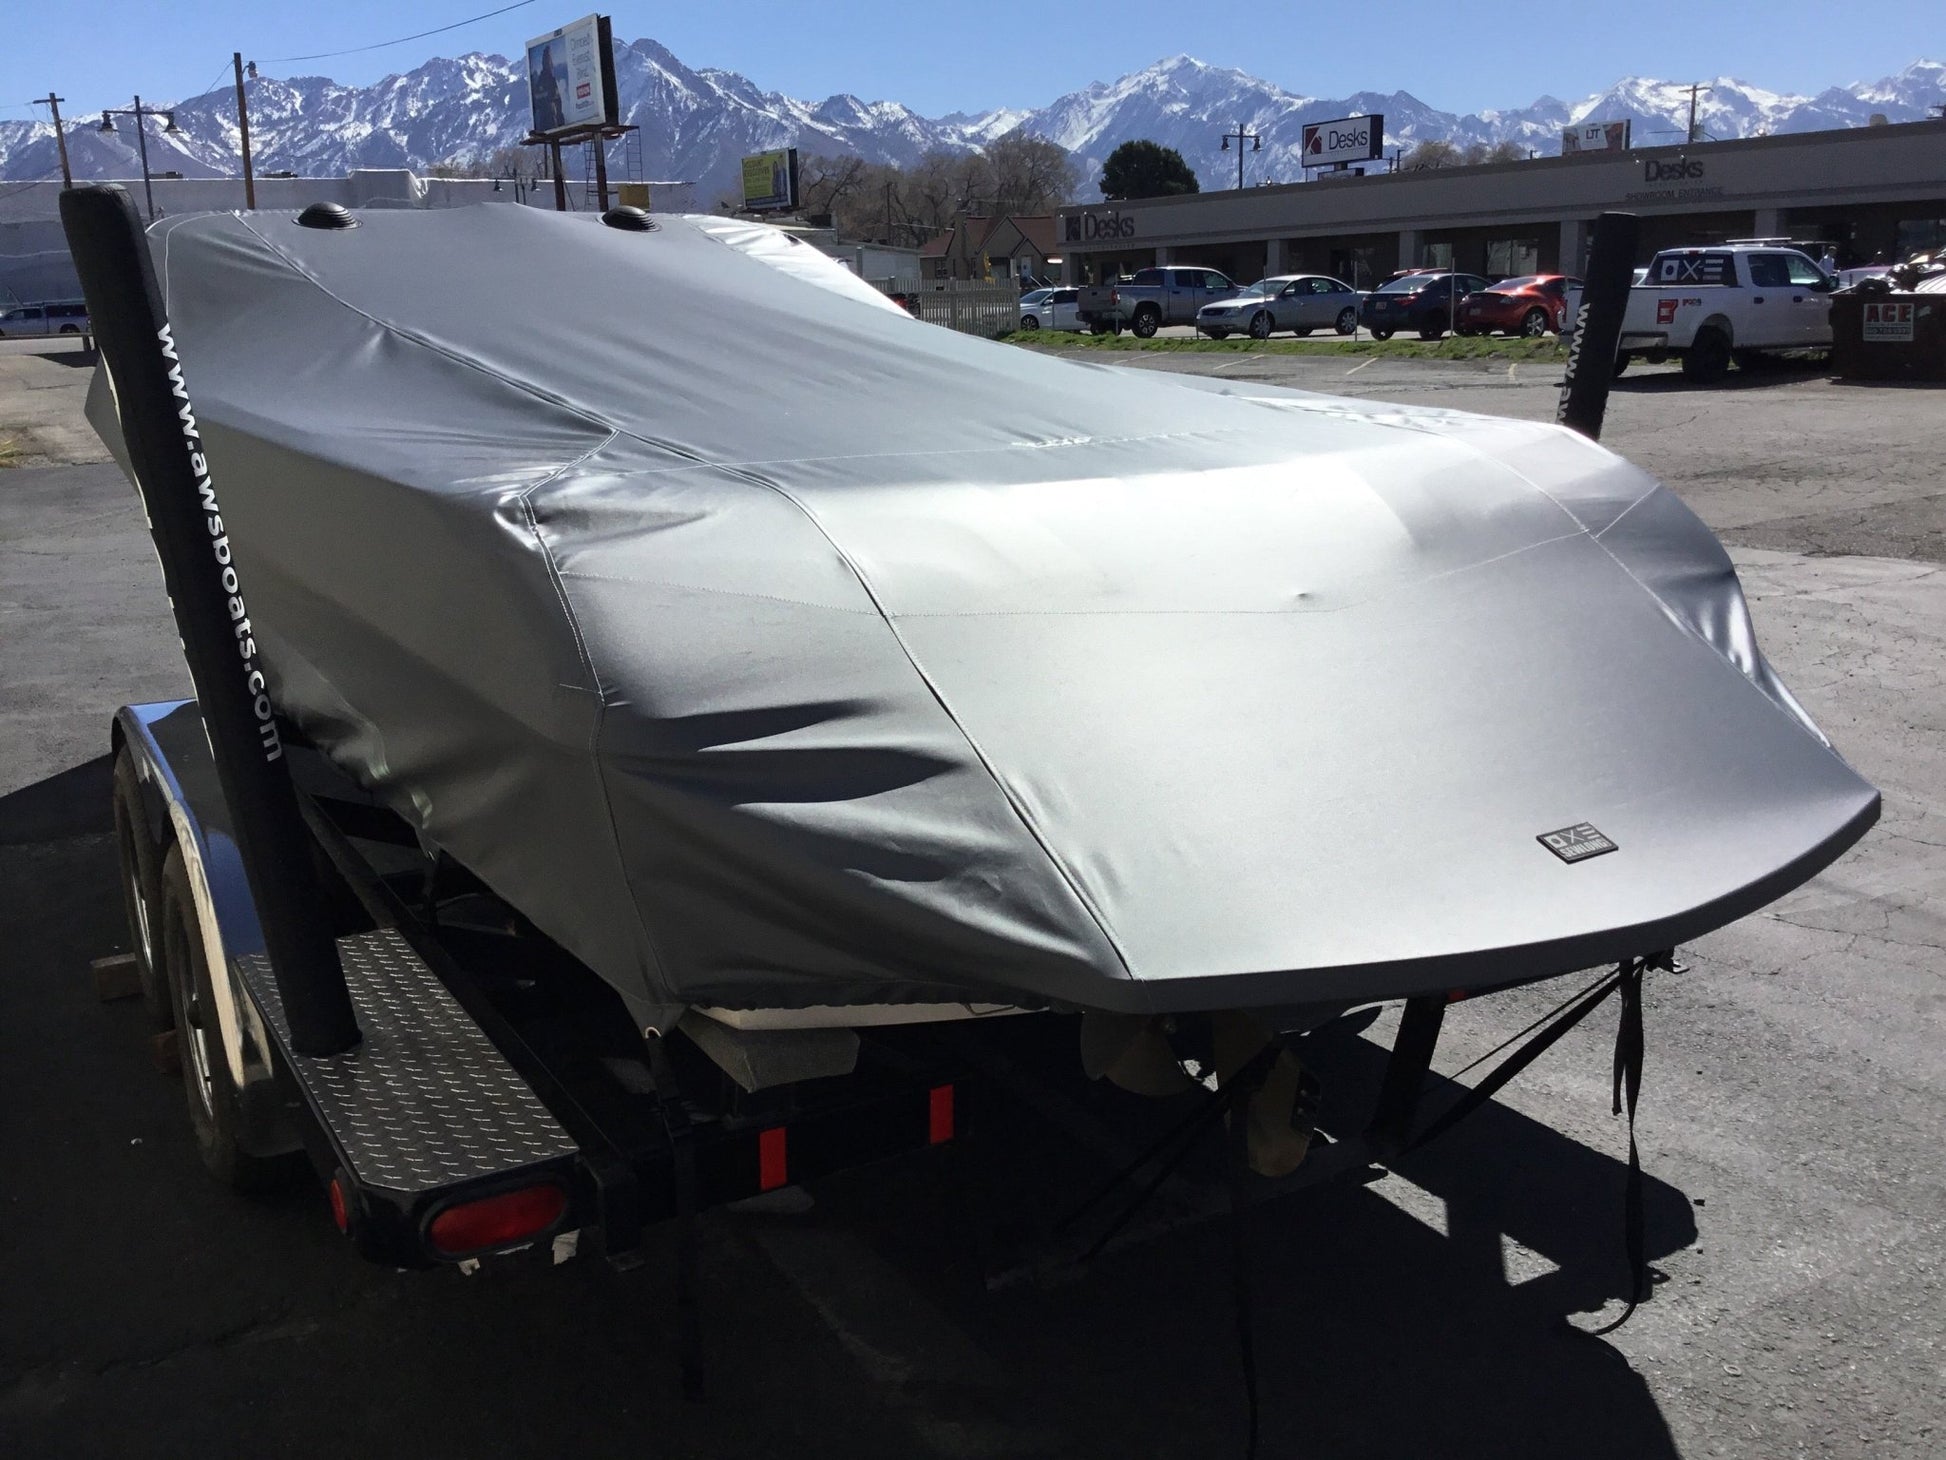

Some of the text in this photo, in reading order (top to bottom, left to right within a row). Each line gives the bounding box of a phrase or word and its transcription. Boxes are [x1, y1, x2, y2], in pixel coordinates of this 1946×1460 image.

[1329, 128, 1368, 150] Desks
[1645, 158, 1703, 182] Desks
[1085, 212, 1135, 240] Desks
[1866, 304, 1912, 322] ACE
[157, 323, 283, 763] www.awsboats.com
